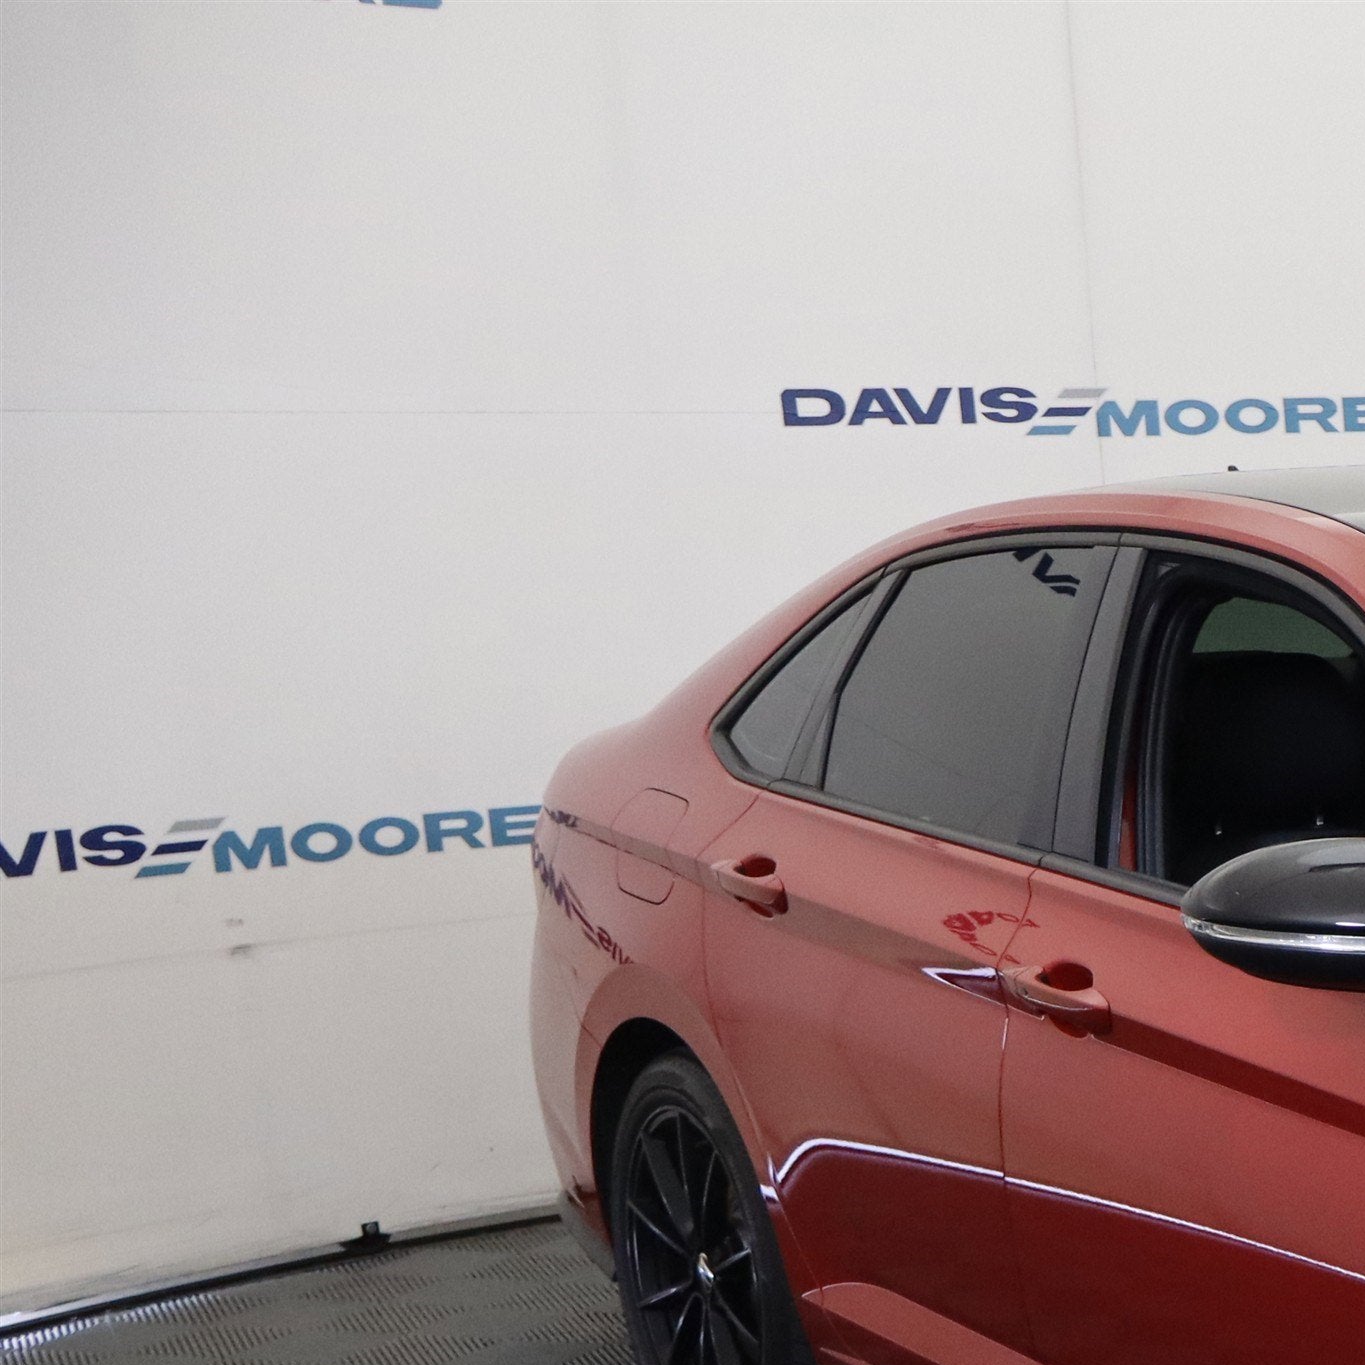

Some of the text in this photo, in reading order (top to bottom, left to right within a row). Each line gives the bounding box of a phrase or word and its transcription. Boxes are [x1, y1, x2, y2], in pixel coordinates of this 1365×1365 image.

[781, 386, 1039, 427] DAVIS
[0, 803, 542, 878] VIS MOORE
